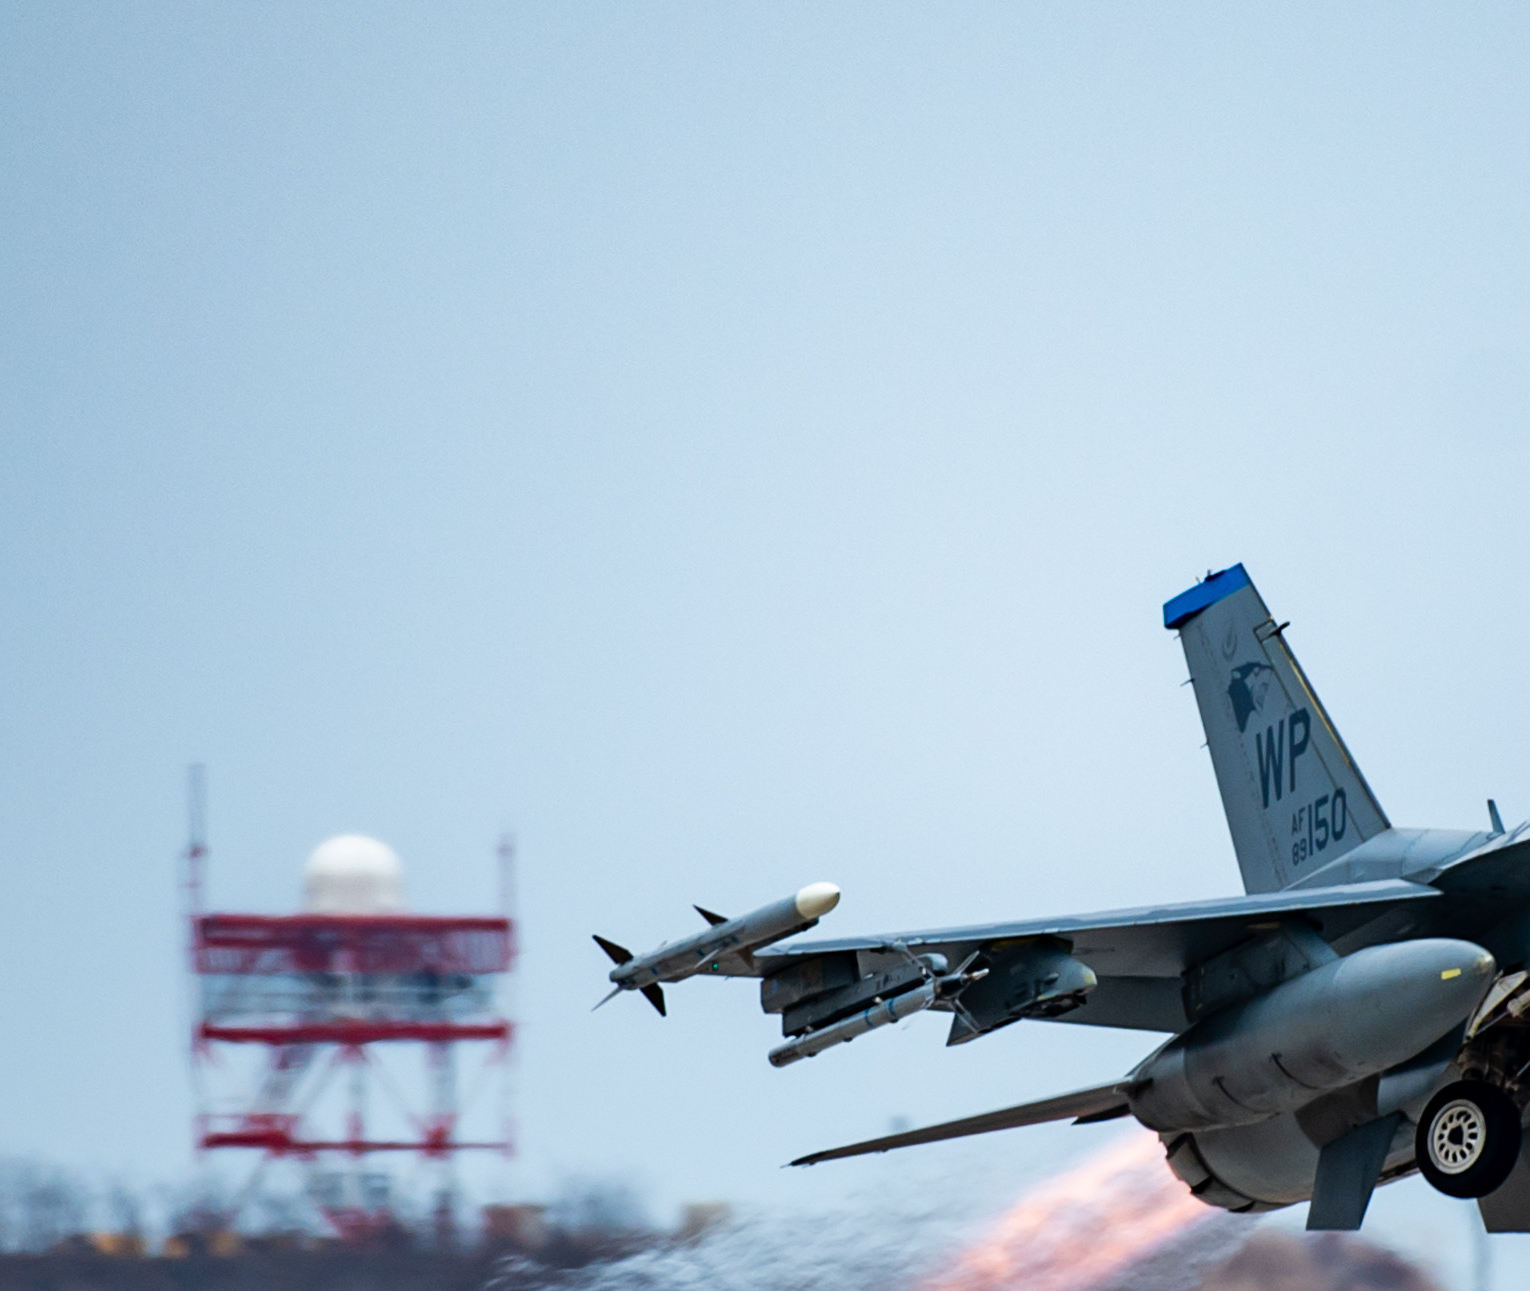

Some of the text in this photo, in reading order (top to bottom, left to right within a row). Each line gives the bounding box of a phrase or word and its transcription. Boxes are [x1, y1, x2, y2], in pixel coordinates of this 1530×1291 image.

[1256, 707, 1310, 809] WP
[1291, 807, 1306, 835] AF
[1308, 787, 1346, 856] 150
[1292, 838, 1307, 866] 89
